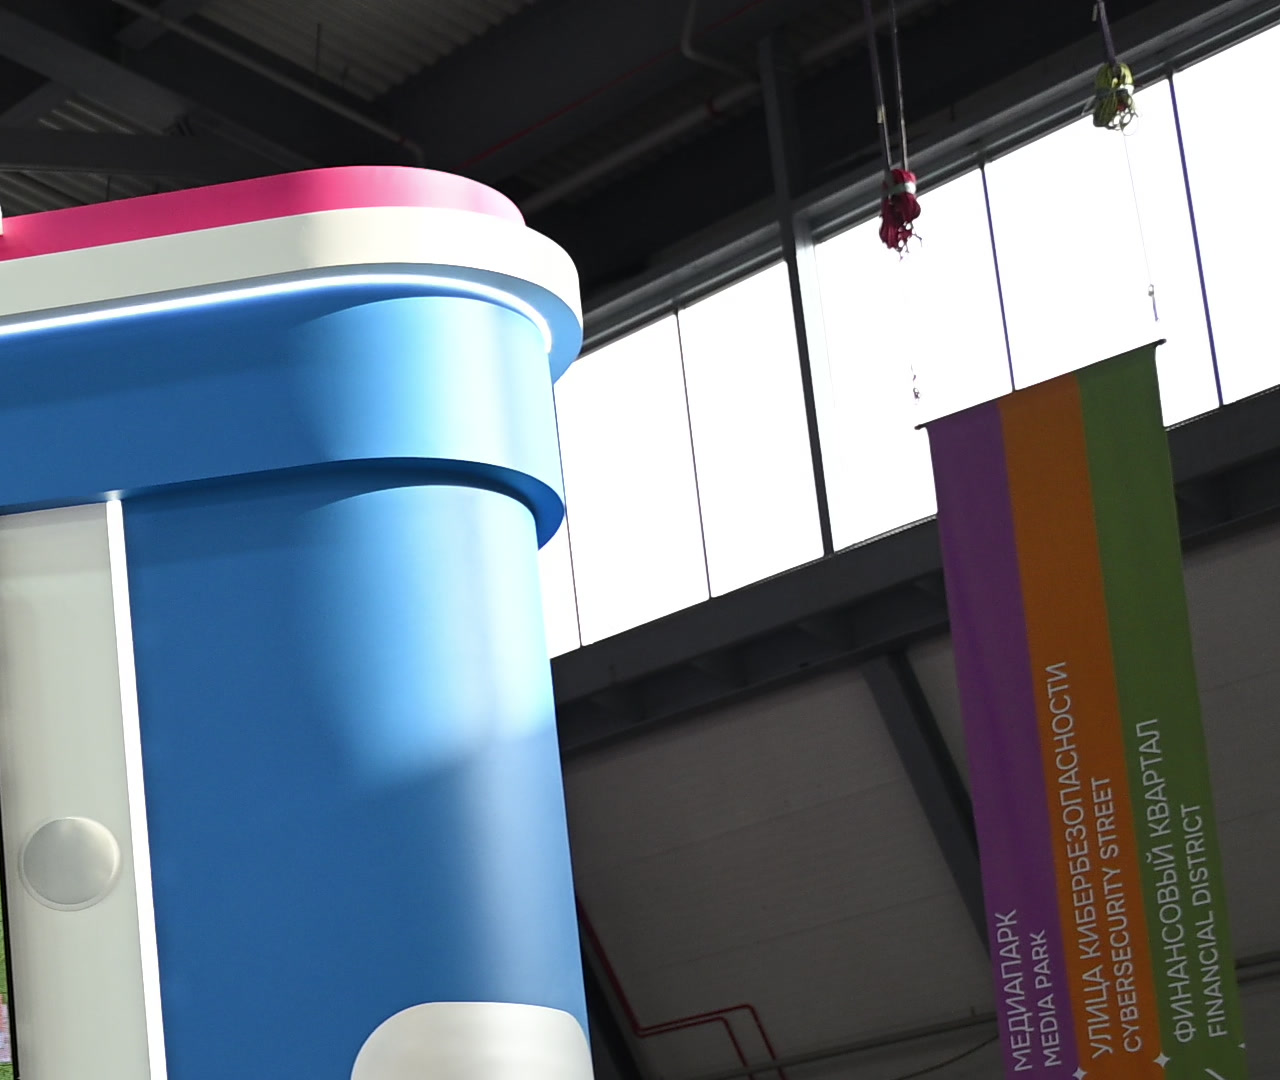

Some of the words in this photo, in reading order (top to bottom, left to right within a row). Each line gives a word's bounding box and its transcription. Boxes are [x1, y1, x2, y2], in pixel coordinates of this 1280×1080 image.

[1046, 661, 1098, 960] КИБЕРБЕЗОПАСНОСТИ
[1092, 777, 1118, 859] STREET
[1136, 718, 1172, 838] КВАРТАЛ
[1180, 803, 1212, 907] DISTRICT
[994, 909, 1032, 1071] МЕДИАПАРК
[1030, 929, 1052, 987] PARK
[1100, 868, 1141, 1052] CYBERSECURITY
[1145, 845, 1195, 1043] ФИНАНСОВЫЙ
[1195, 910, 1227, 1038] FINANCIAL
[1038, 1000, 1062, 1067] MEDIA
[1082, 964, 1115, 1058] УЛИЦА
